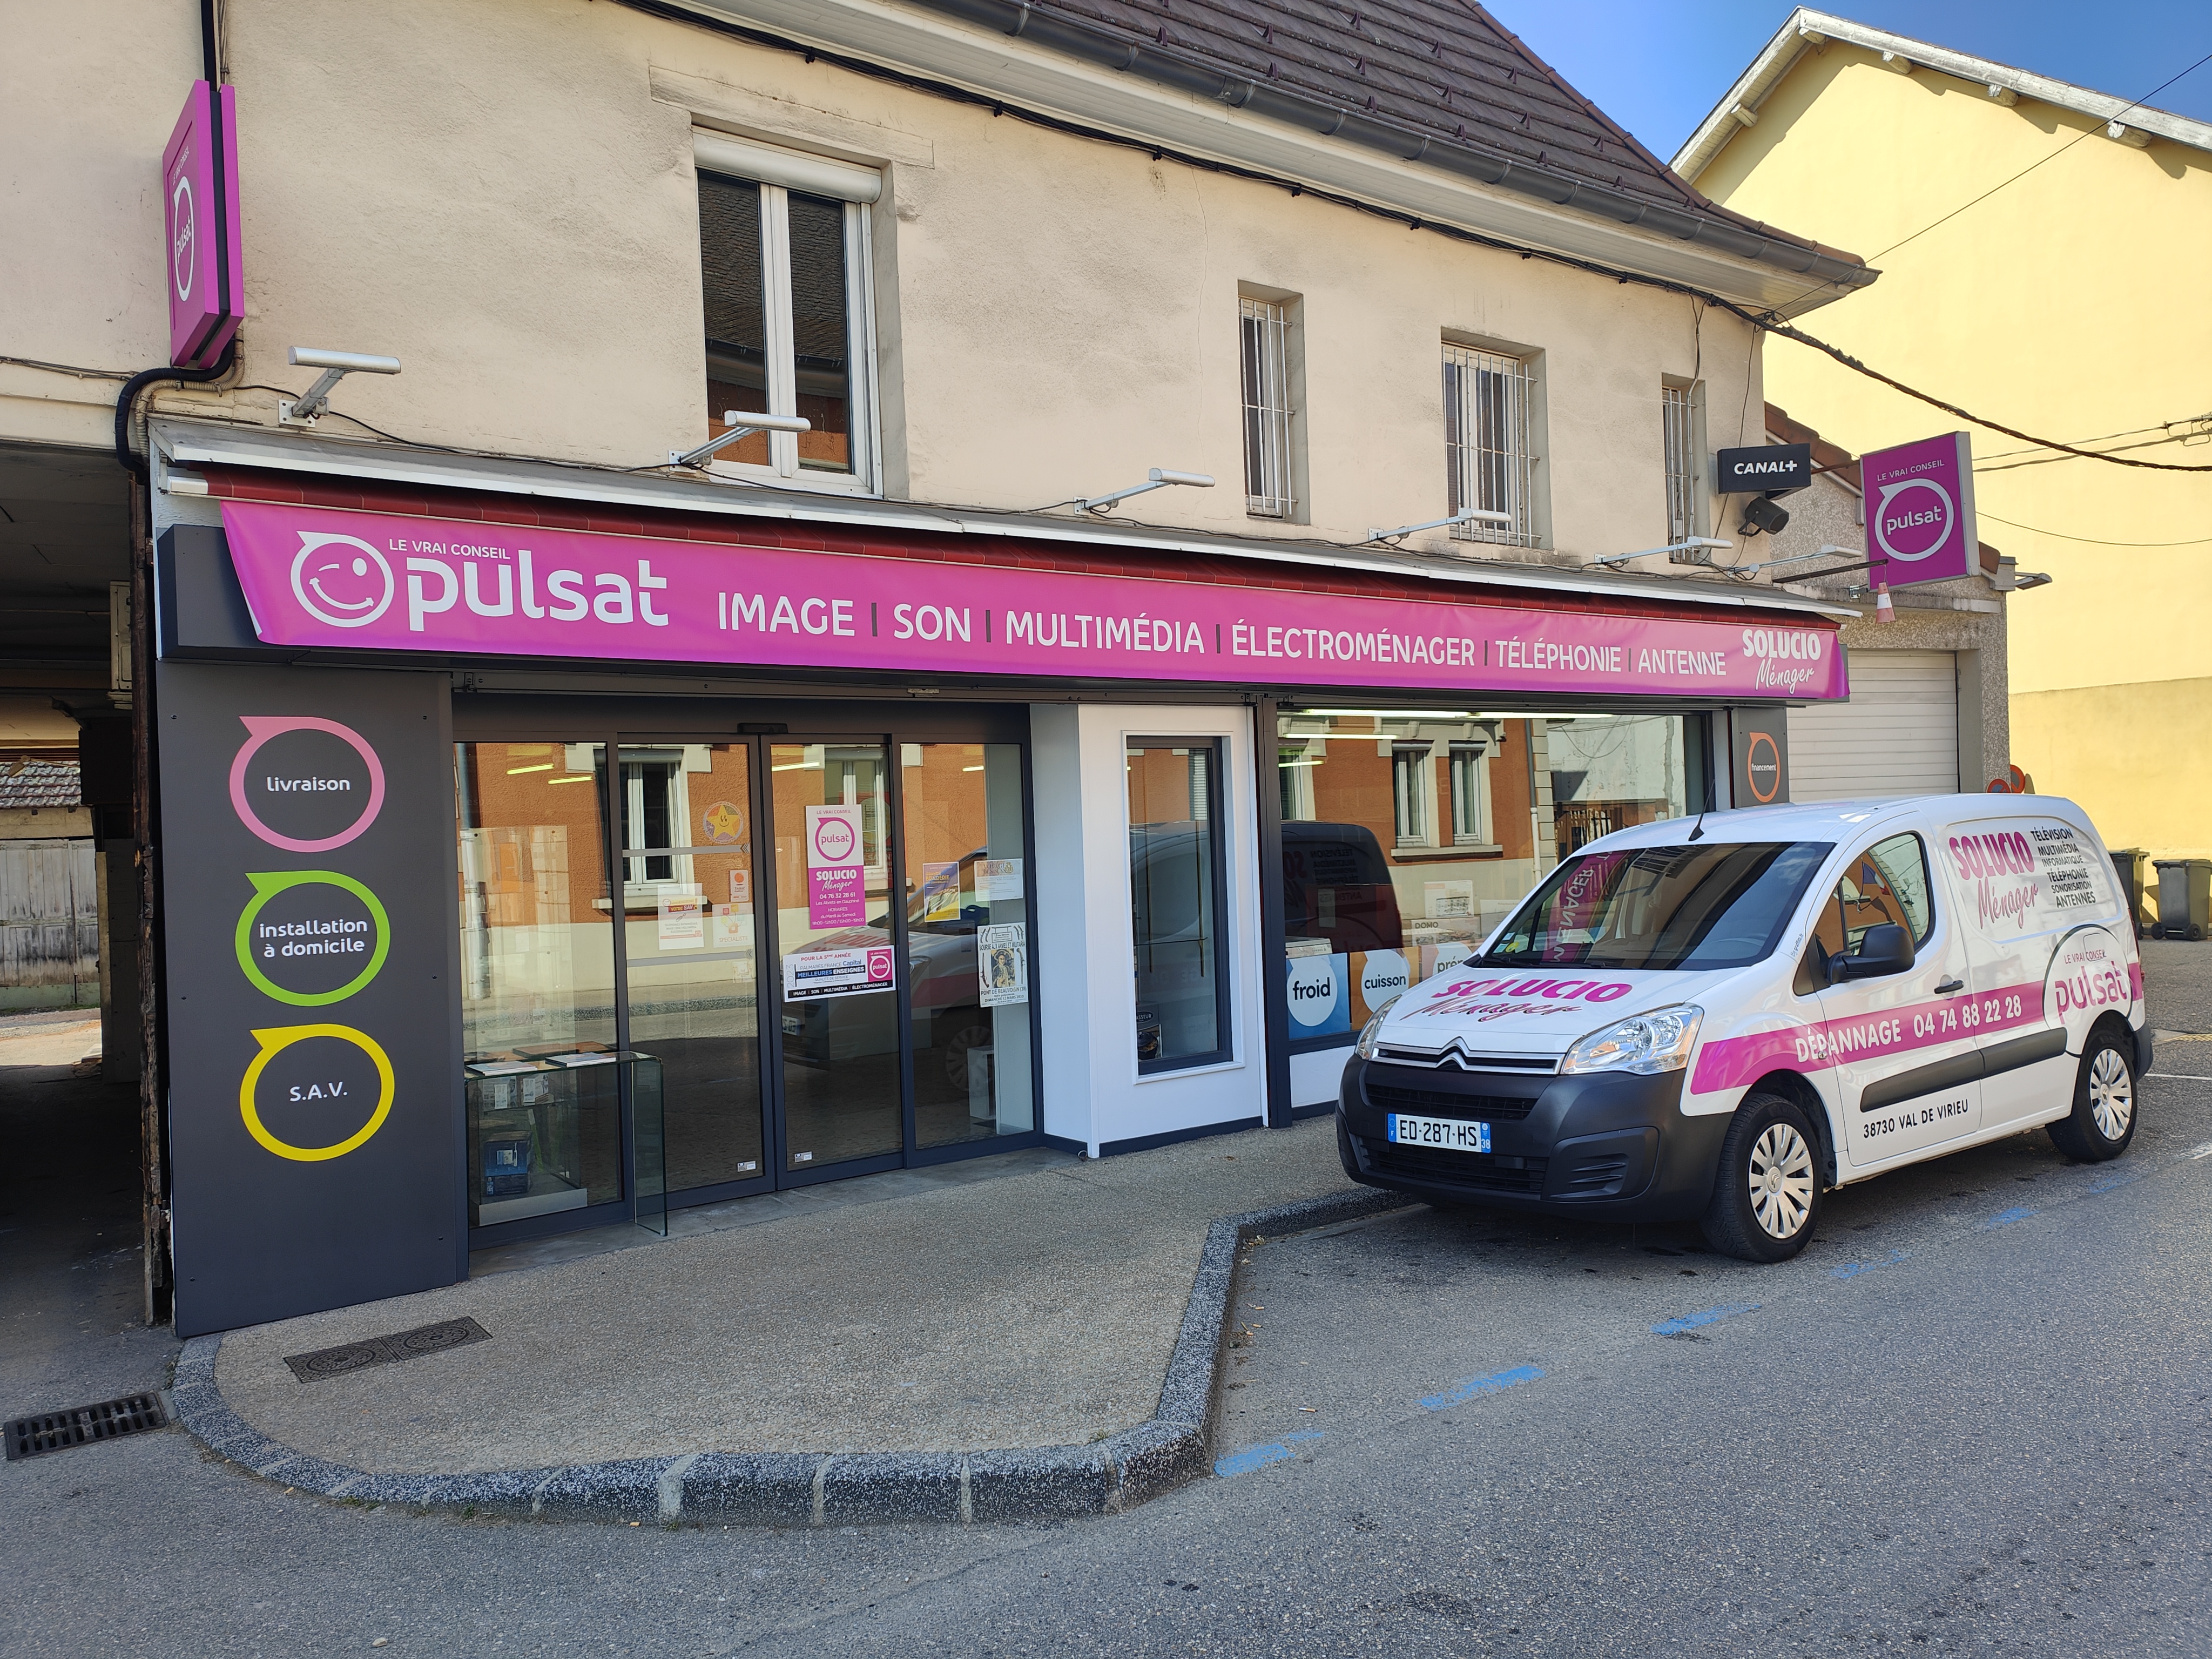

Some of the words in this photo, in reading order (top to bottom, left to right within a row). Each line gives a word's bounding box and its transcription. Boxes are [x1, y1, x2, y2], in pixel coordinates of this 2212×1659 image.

[177, 215, 191, 265] pulsat
[1734, 460, 1798, 475] CANAL+
[1877, 474, 1887, 482] LE
[1889, 468, 1908, 478] VRAI
[1910, 459, 1945, 474] CONSEIL
[1886, 505, 1942, 535] pulsat
[388, 538, 408, 551] LE
[412, 541, 447, 555] VRAI
[450, 542, 511, 561] CONSEIL
[407, 549, 669, 632] pulsat
[718, 592, 855, 636] IMAGE
[893, 603, 971, 642] SON
[1006, 610, 1204, 655] MULTIMÉDIA
[1232, 618, 1475, 666] ÉLECTROMÉNAGER
[1495, 636, 1621, 672] TÉLÉPHONIE
[1638, 648, 1727, 676] ANTENNE
[1742, 628, 1822, 660] SOLUCIO
[1755, 658, 1815, 695] Ménager
[1751, 763, 1776, 771] financement
[266, 776, 351, 792] livraison
[821, 834, 849, 845] pulsat
[2031, 826, 2073, 841] TÉLÉVISION
[1949, 831, 2035, 881] SOLUCIO
[2038, 841, 2080, 857] MULTIMÉDIA
[2041, 855, 2083, 867] INFORMATIQUE
[816, 869, 857, 881] SOLUCIO
[2047, 867, 2089, 882] TÉLÉPHONIE
[822, 880, 853, 891] Ménager
[2051, 880, 2092, 894] SONORISATION
[1978, 876, 2038, 930] Ménager
[2055, 891, 2096, 908] ANTENNES
[259, 918, 368, 939] installation
[1415, 921, 1439, 929] DOMO
[263, 943, 275, 959] à
[281, 938, 365, 957] domicile
[2064, 954, 2070, 965] LE
[2072, 952, 2085, 963] VRAI
[2086, 949, 2107, 961] CONSEIL
[786, 964, 794, 988] 2023
[1364, 974, 1406, 990] cuisson
[1292, 976, 1331, 1001] froid
[1431, 979, 1633, 1002] SOLUCIO
[2055, 961, 2127, 1024] pulsat
[1400, 995, 1583, 1022] Ménager
[1795, 1018, 1901, 1063] DÉPANNAGE
[1913, 1014, 1936, 1039] 04
[1940, 1009, 1958, 1034] 74
[1962, 1002, 1979, 1029] 88
[1984, 999, 2002, 1024] 22
[2005, 994, 2022, 1020] 28
[289, 1081, 348, 1103] S.A.V.
[1863, 1118, 1895, 1138] 38730
[1899, 1114, 1918, 1131] VAL
[1921, 1110, 1934, 1124] DE
[1937, 1098, 1969, 1120] VIRIEU
[1481, 1138, 1491, 1149] 38
